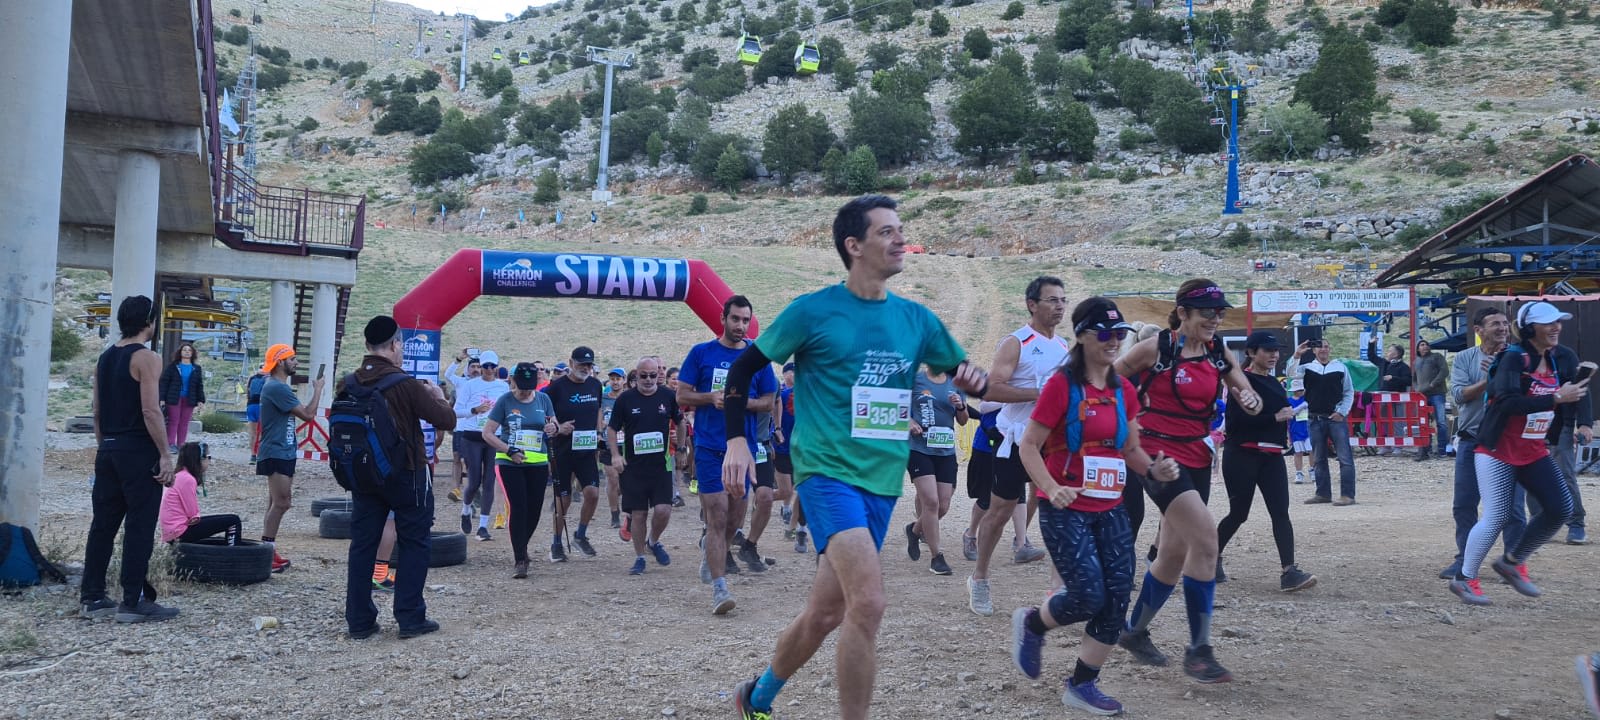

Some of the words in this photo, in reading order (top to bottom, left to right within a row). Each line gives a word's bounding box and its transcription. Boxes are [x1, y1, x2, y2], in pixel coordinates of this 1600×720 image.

[492, 268, 543, 280] HERMON
[555, 254, 682, 298] START
[403, 342, 434, 351] ERMON
[870, 406, 897, 425] 358
[579, 436, 591, 445] 312
[641, 439, 656, 449] 314
[935, 434, 949, 443] 357
[1100, 472, 1115, 488] 80
